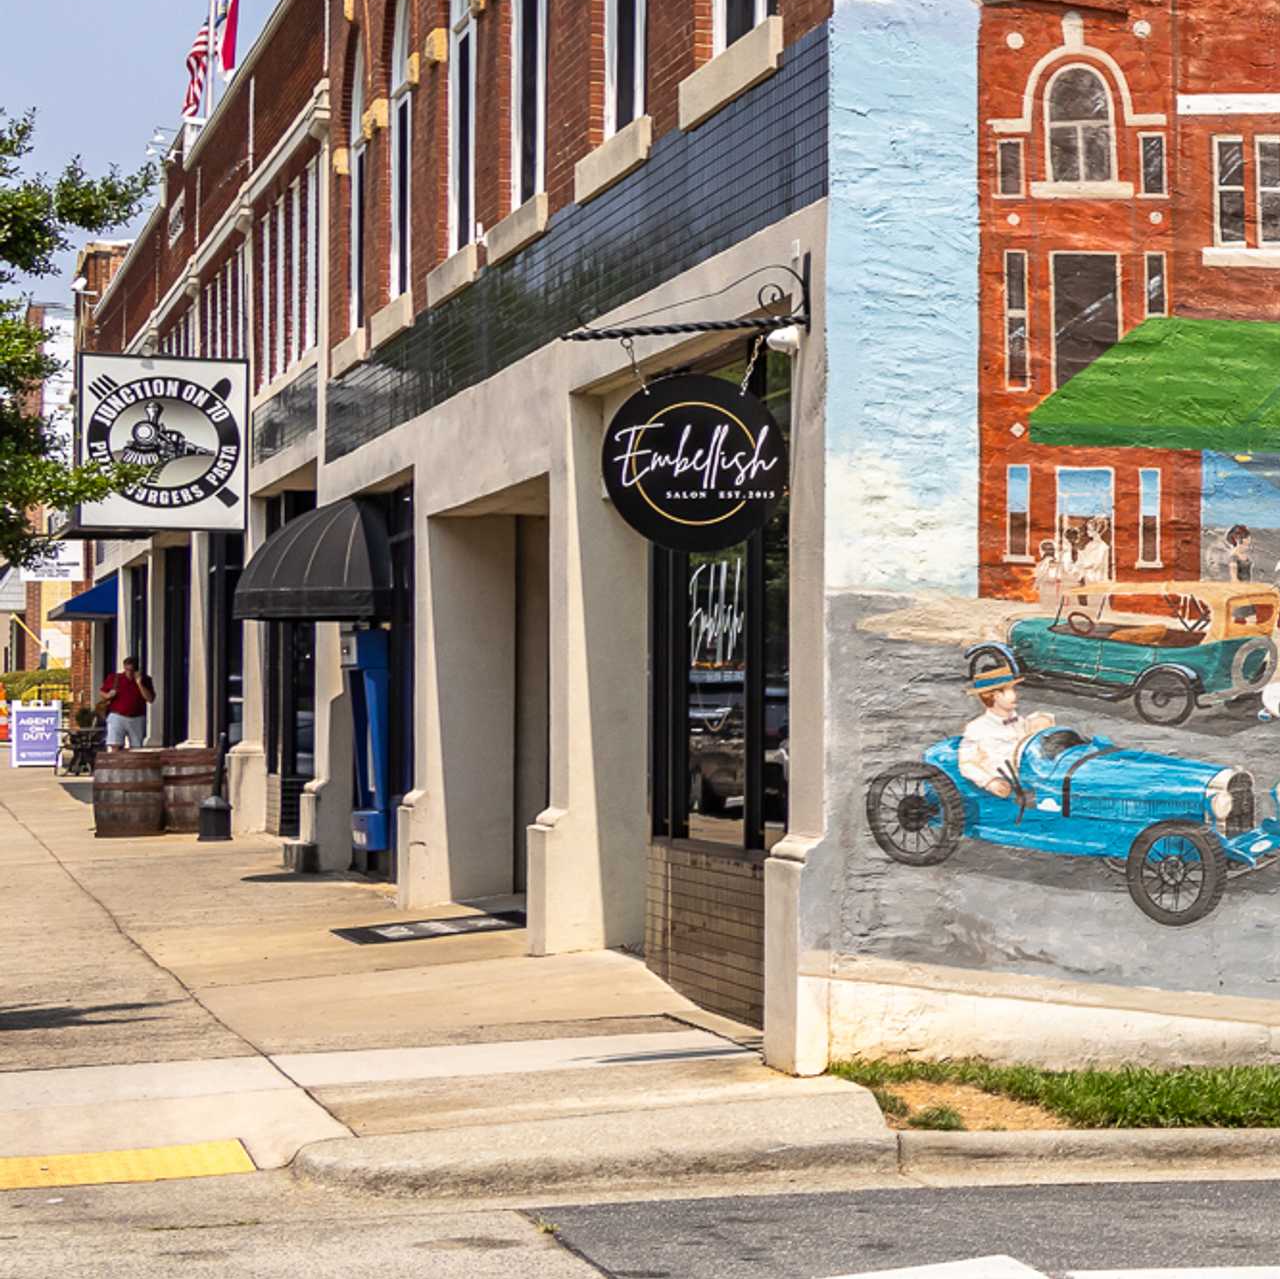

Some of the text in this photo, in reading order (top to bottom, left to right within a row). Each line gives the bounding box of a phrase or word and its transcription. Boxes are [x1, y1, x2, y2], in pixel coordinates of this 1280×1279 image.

[93, 378, 231, 427] JUNCTION ON 70
[205, 445, 238, 486] PASTA
[612, 422, 779, 490] Embellish
[665, 490, 708, 500] SALON
[19, 717, 55, 726] AGENT
[22, 732, 53, 741] DUTY
